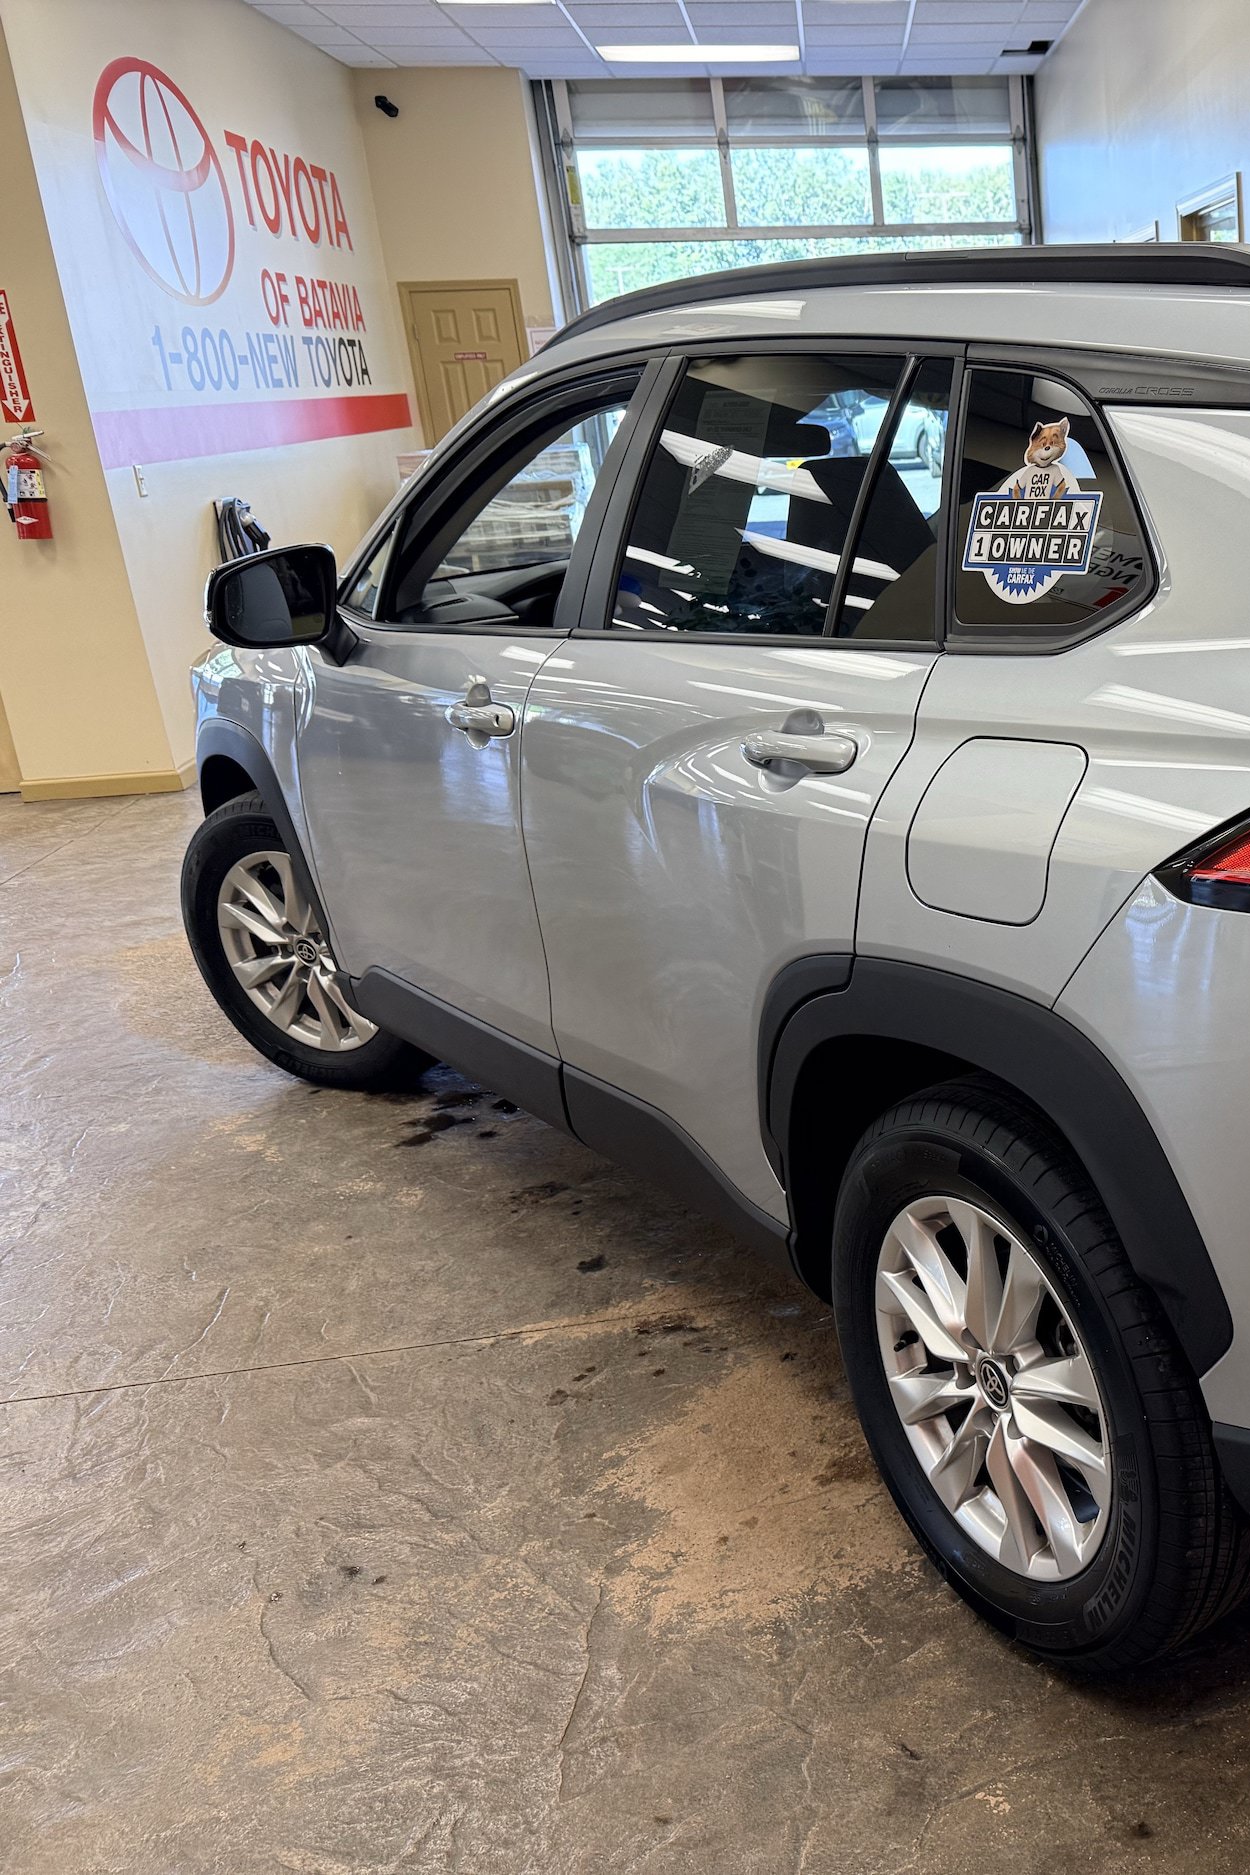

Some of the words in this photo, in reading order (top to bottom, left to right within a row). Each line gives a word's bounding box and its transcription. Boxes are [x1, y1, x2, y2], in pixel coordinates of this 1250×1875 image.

[224, 130, 353, 251] TOYOTA
[261, 268, 289, 326] OF
[295, 276, 367, 332] BATAVIA
[152, 325, 299, 391] 1-800-NEW
[302, 335, 372, 389] TOYOTA
[1135, 386, 1195, 396] CROSS
[1029, 486, 1046, 498] FOX
[1031, 473, 1050, 486] CAR
[979, 504, 1089, 530] CARFAX
[1007, 573, 1035, 584] CARFAX
[1086, 1509, 1137, 1631] MICHELIN
